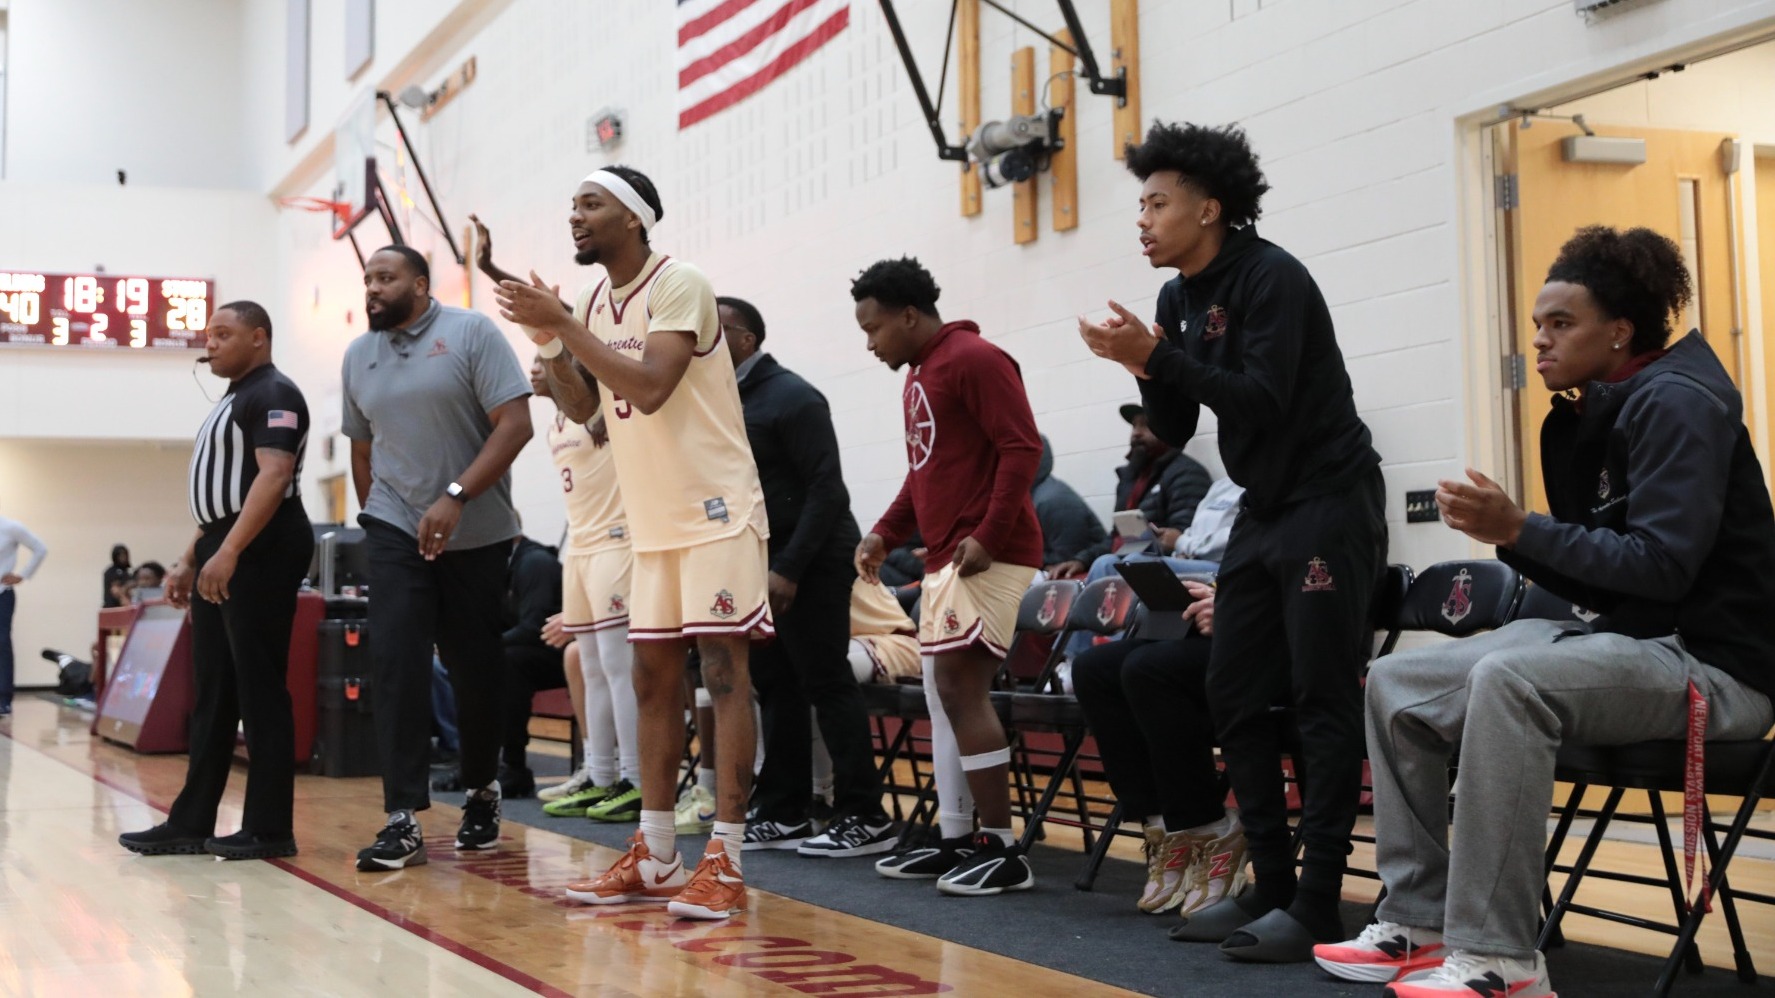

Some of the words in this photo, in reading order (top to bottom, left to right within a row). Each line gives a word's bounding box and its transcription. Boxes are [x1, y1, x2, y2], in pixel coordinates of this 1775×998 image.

[0, 292, 40, 325] 40
[166, 297, 207, 331] 28
[52, 317, 69, 345] 3
[90, 313, 108, 341] 2
[129, 319, 147, 348] 3
[561, 467, 573, 493] 3
[713, 594, 734, 615] AS
[1693, 699, 1707, 760] NEWPORT
[1685, 804, 1699, 857] MISSION
